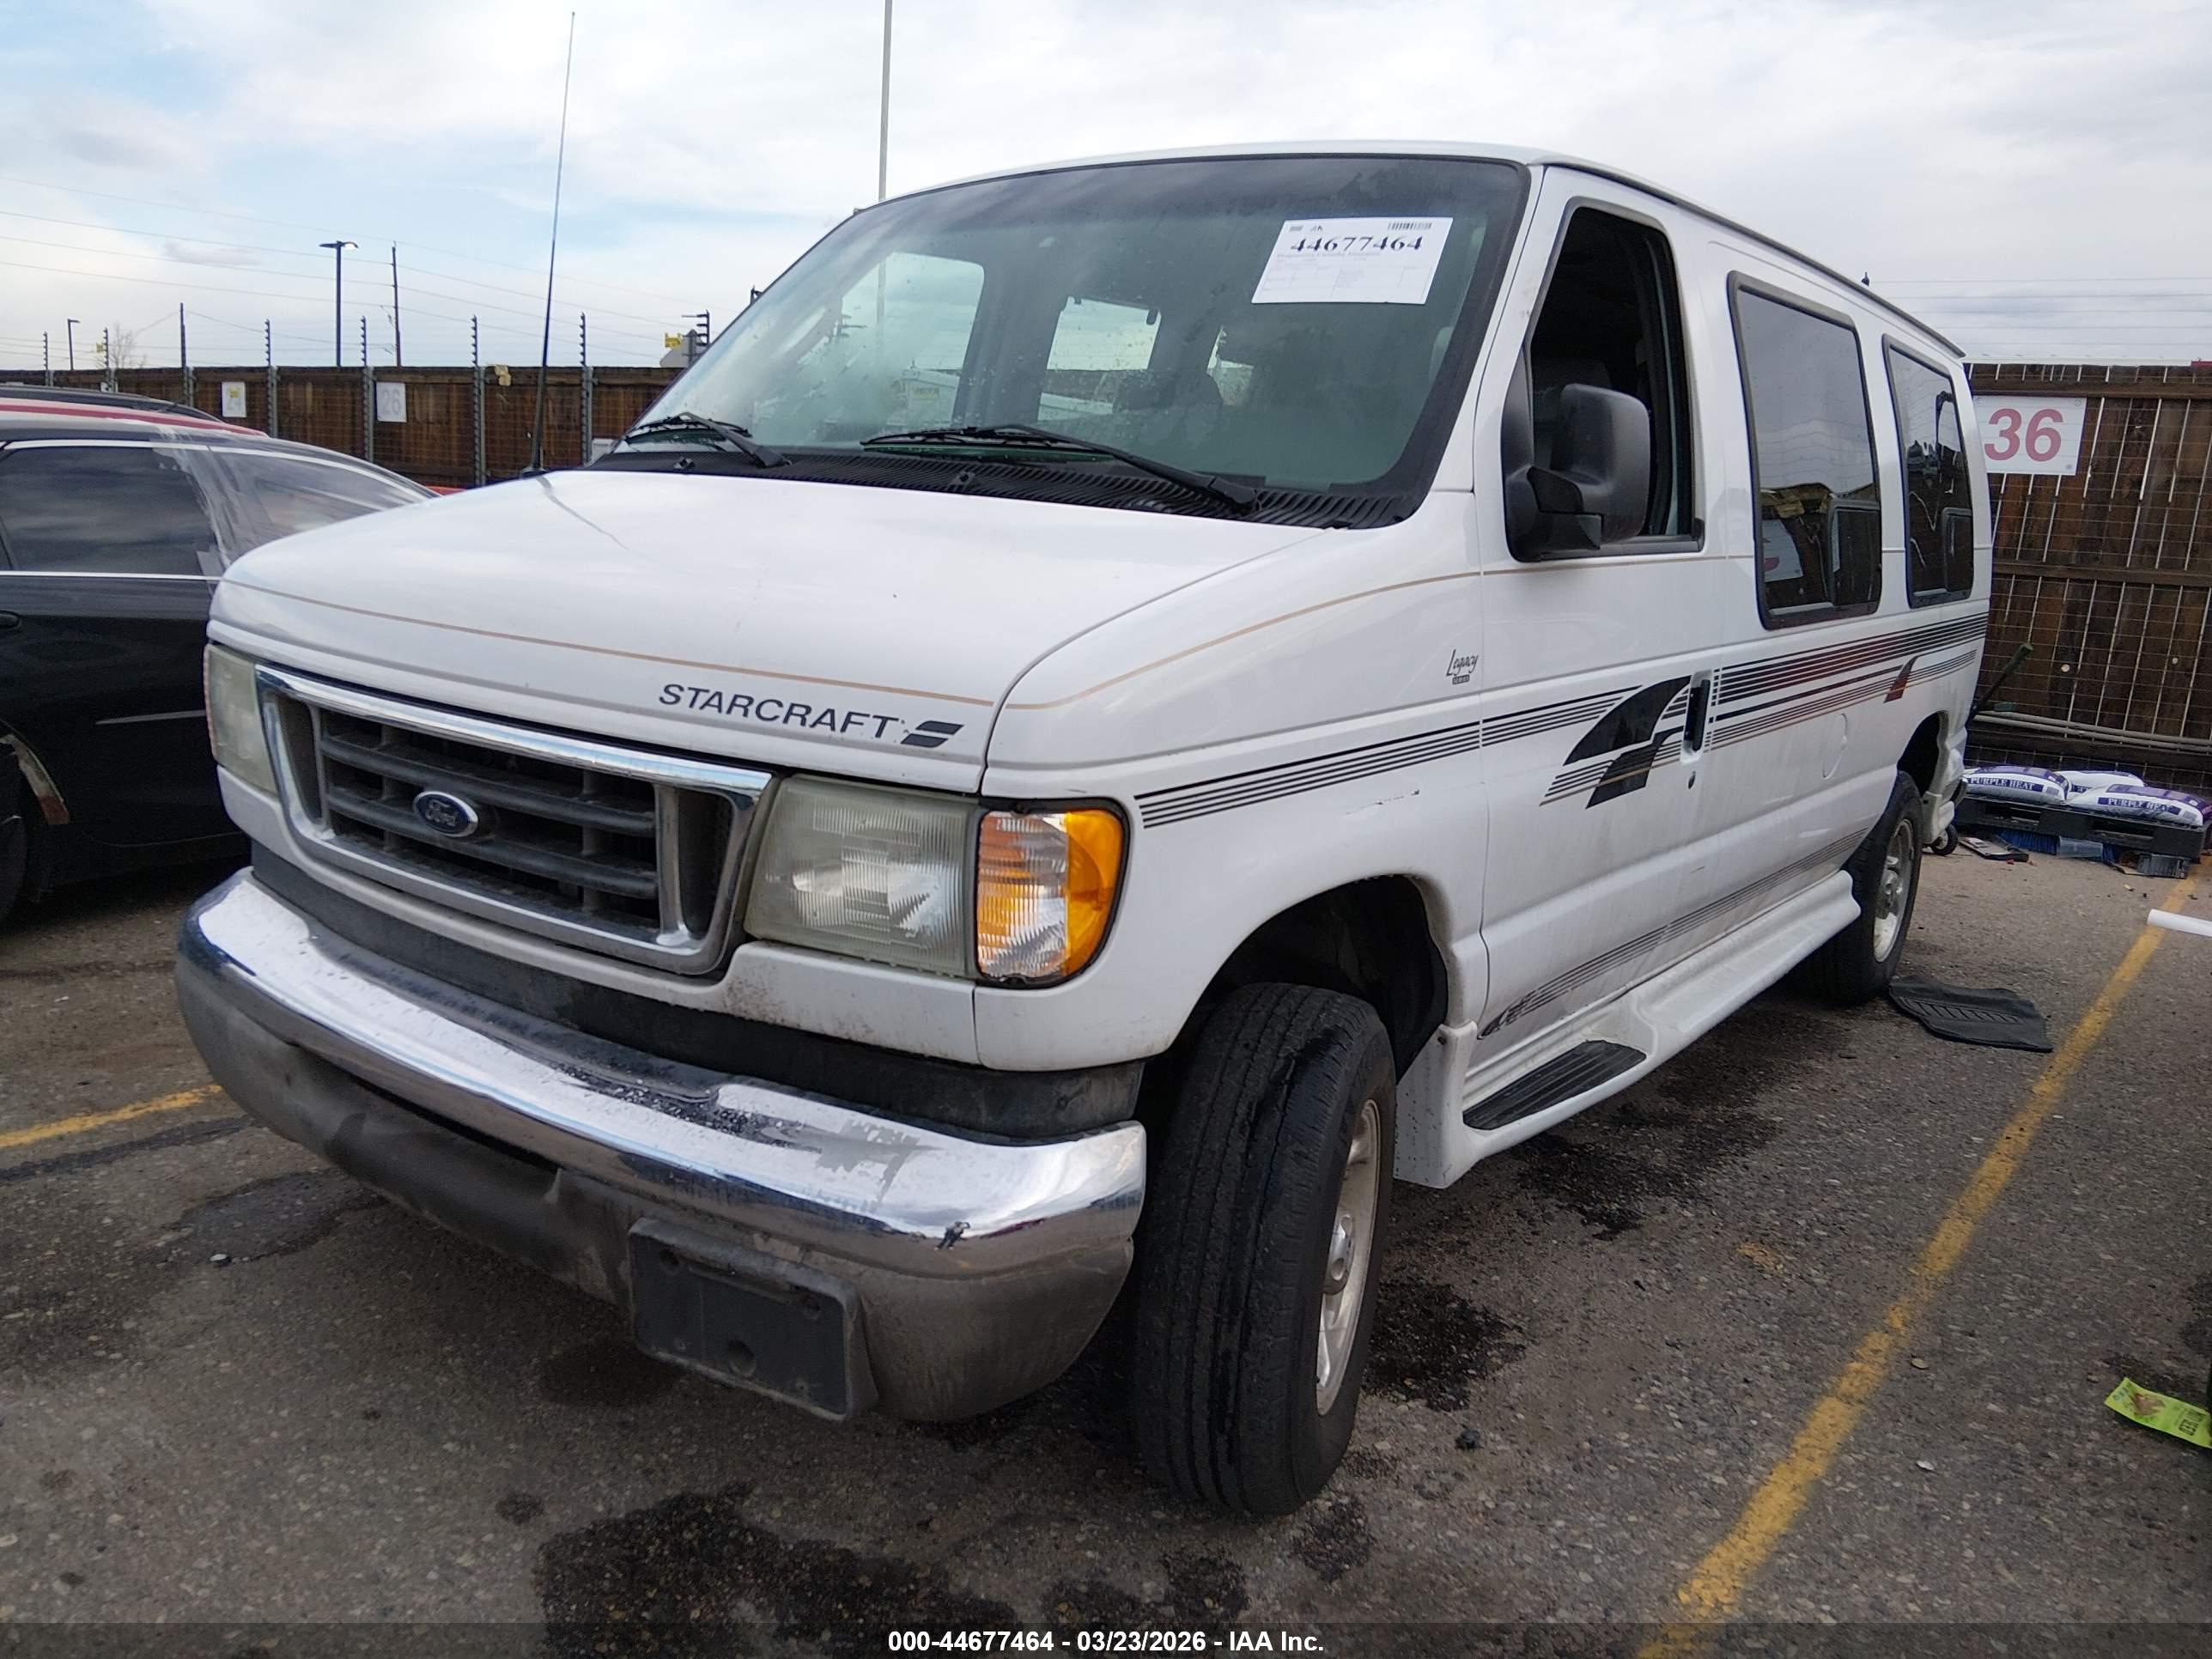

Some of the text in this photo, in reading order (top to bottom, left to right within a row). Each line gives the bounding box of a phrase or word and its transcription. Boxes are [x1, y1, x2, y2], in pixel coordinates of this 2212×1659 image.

[1290, 235, 1423, 252] 44677464
[381, 388, 401, 416] 26
[1984, 407, 2064, 462] 36
[1445, 648, 1479, 677] Legacy
[659, 684, 900, 739] STARCRAFT
[1970, 776, 2036, 790] PURPLE HEAT
[424, 799, 459, 827] Ford
[2107, 797, 2146, 808] PURPLE
